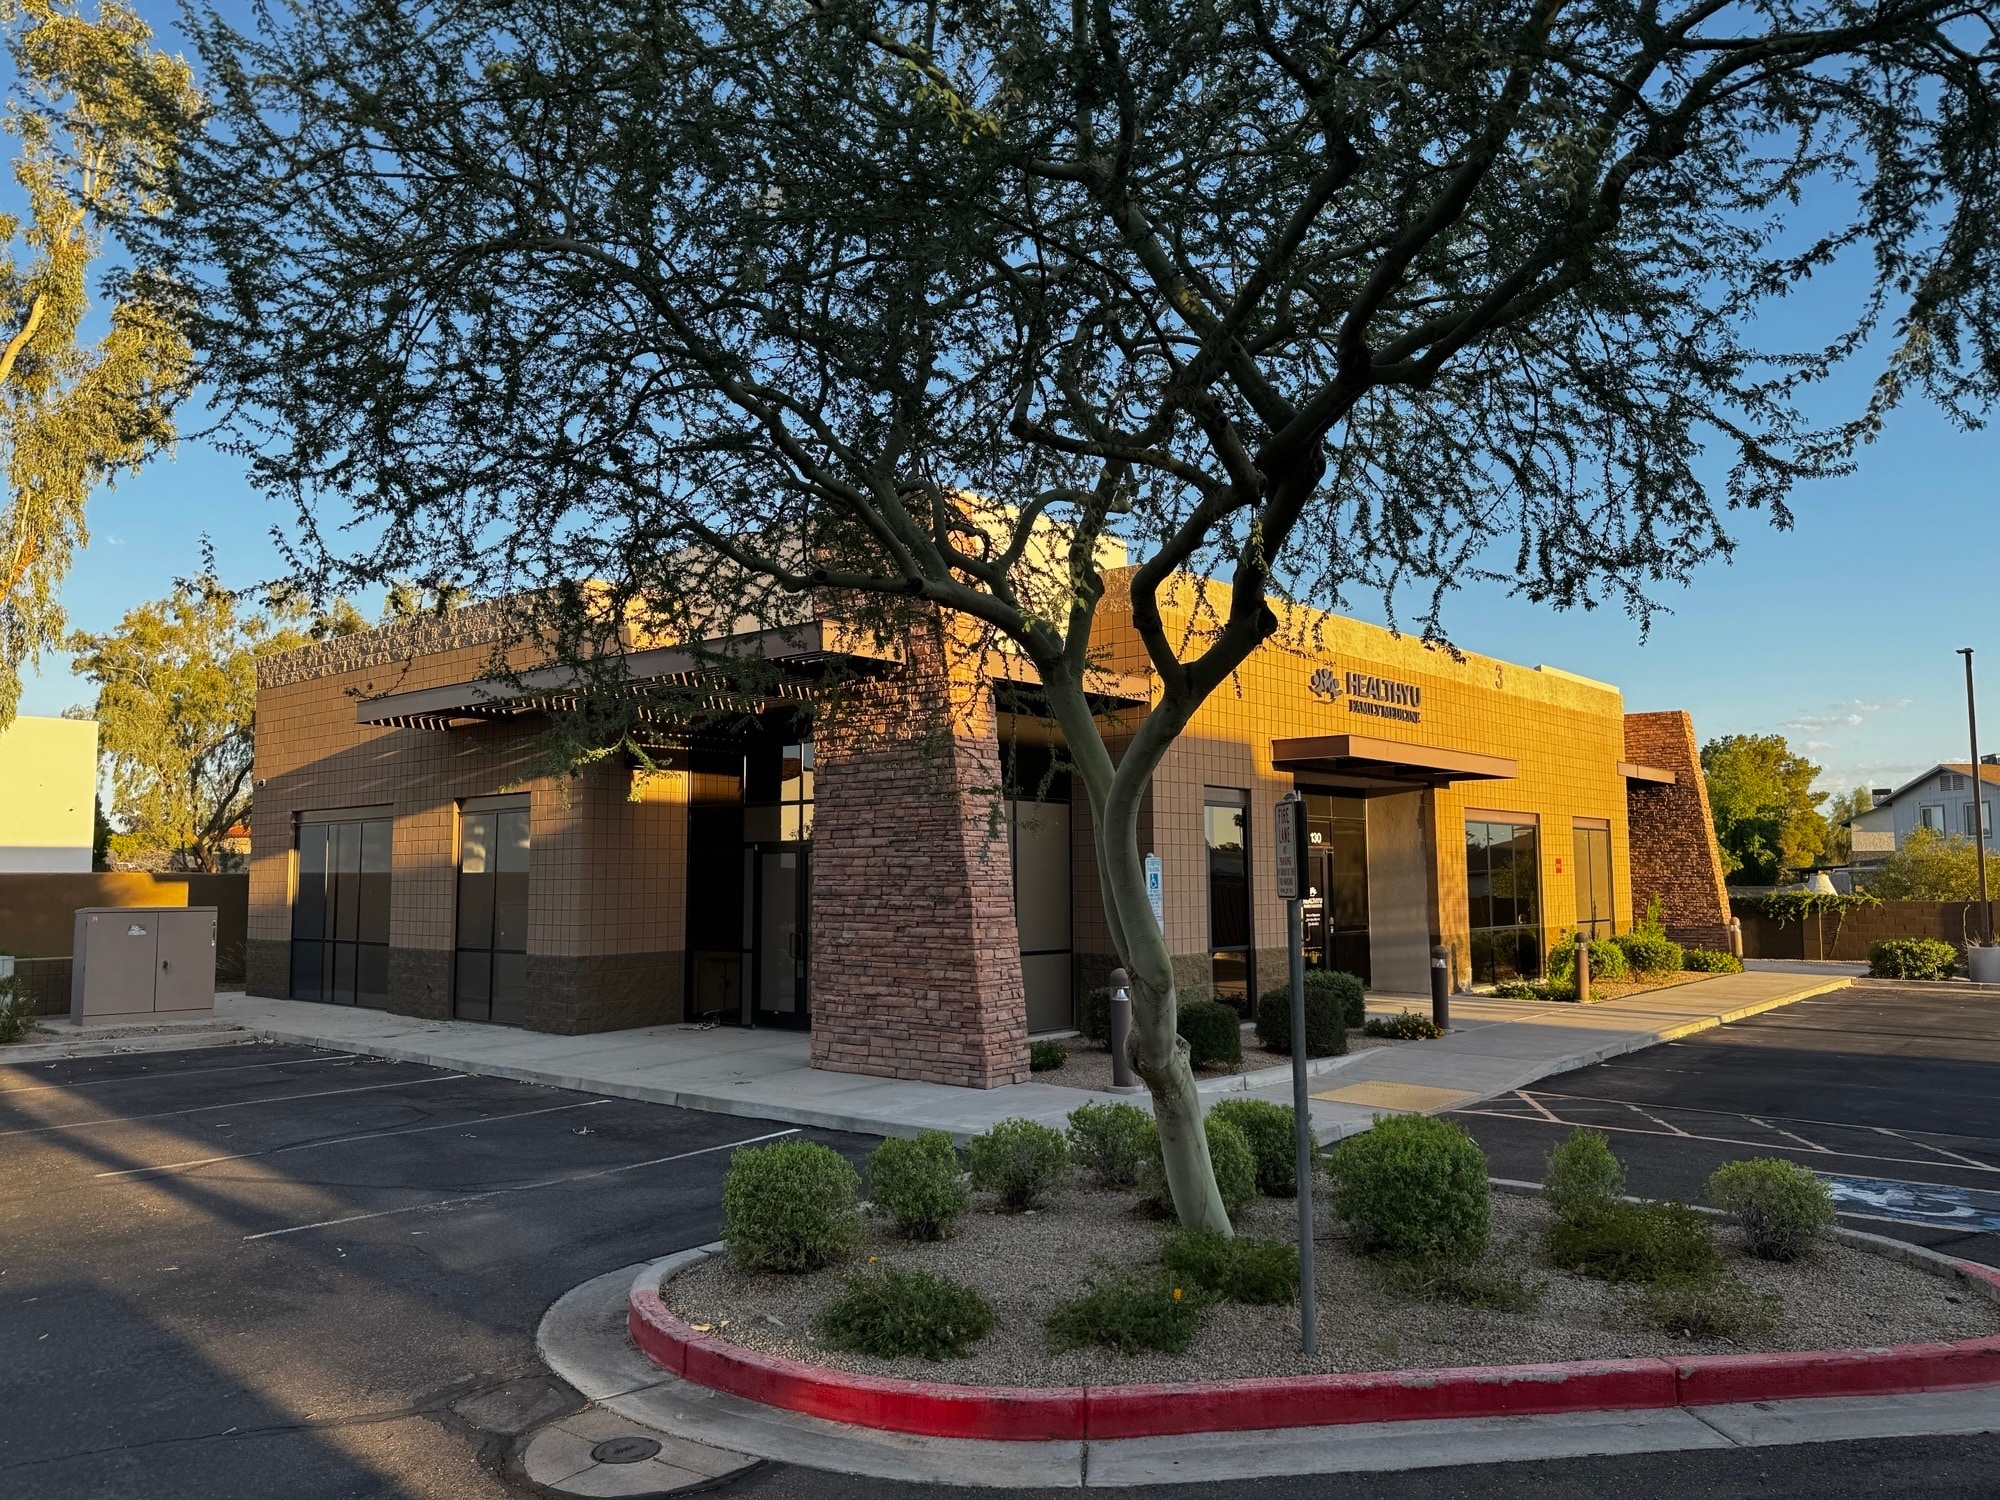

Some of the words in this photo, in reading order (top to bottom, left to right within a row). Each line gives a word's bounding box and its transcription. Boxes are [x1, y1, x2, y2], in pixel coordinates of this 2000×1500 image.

[1495, 664, 1503, 689] 3
[1346, 672, 1421, 707] HEALTHYU
[1349, 700, 1380, 717] FAMILY
[1381, 706, 1421, 724] MEDICINE
[1279, 807, 1290, 824] FIRE
[1279, 827, 1290, 843] LANE
[1310, 832, 1322, 844] 130
